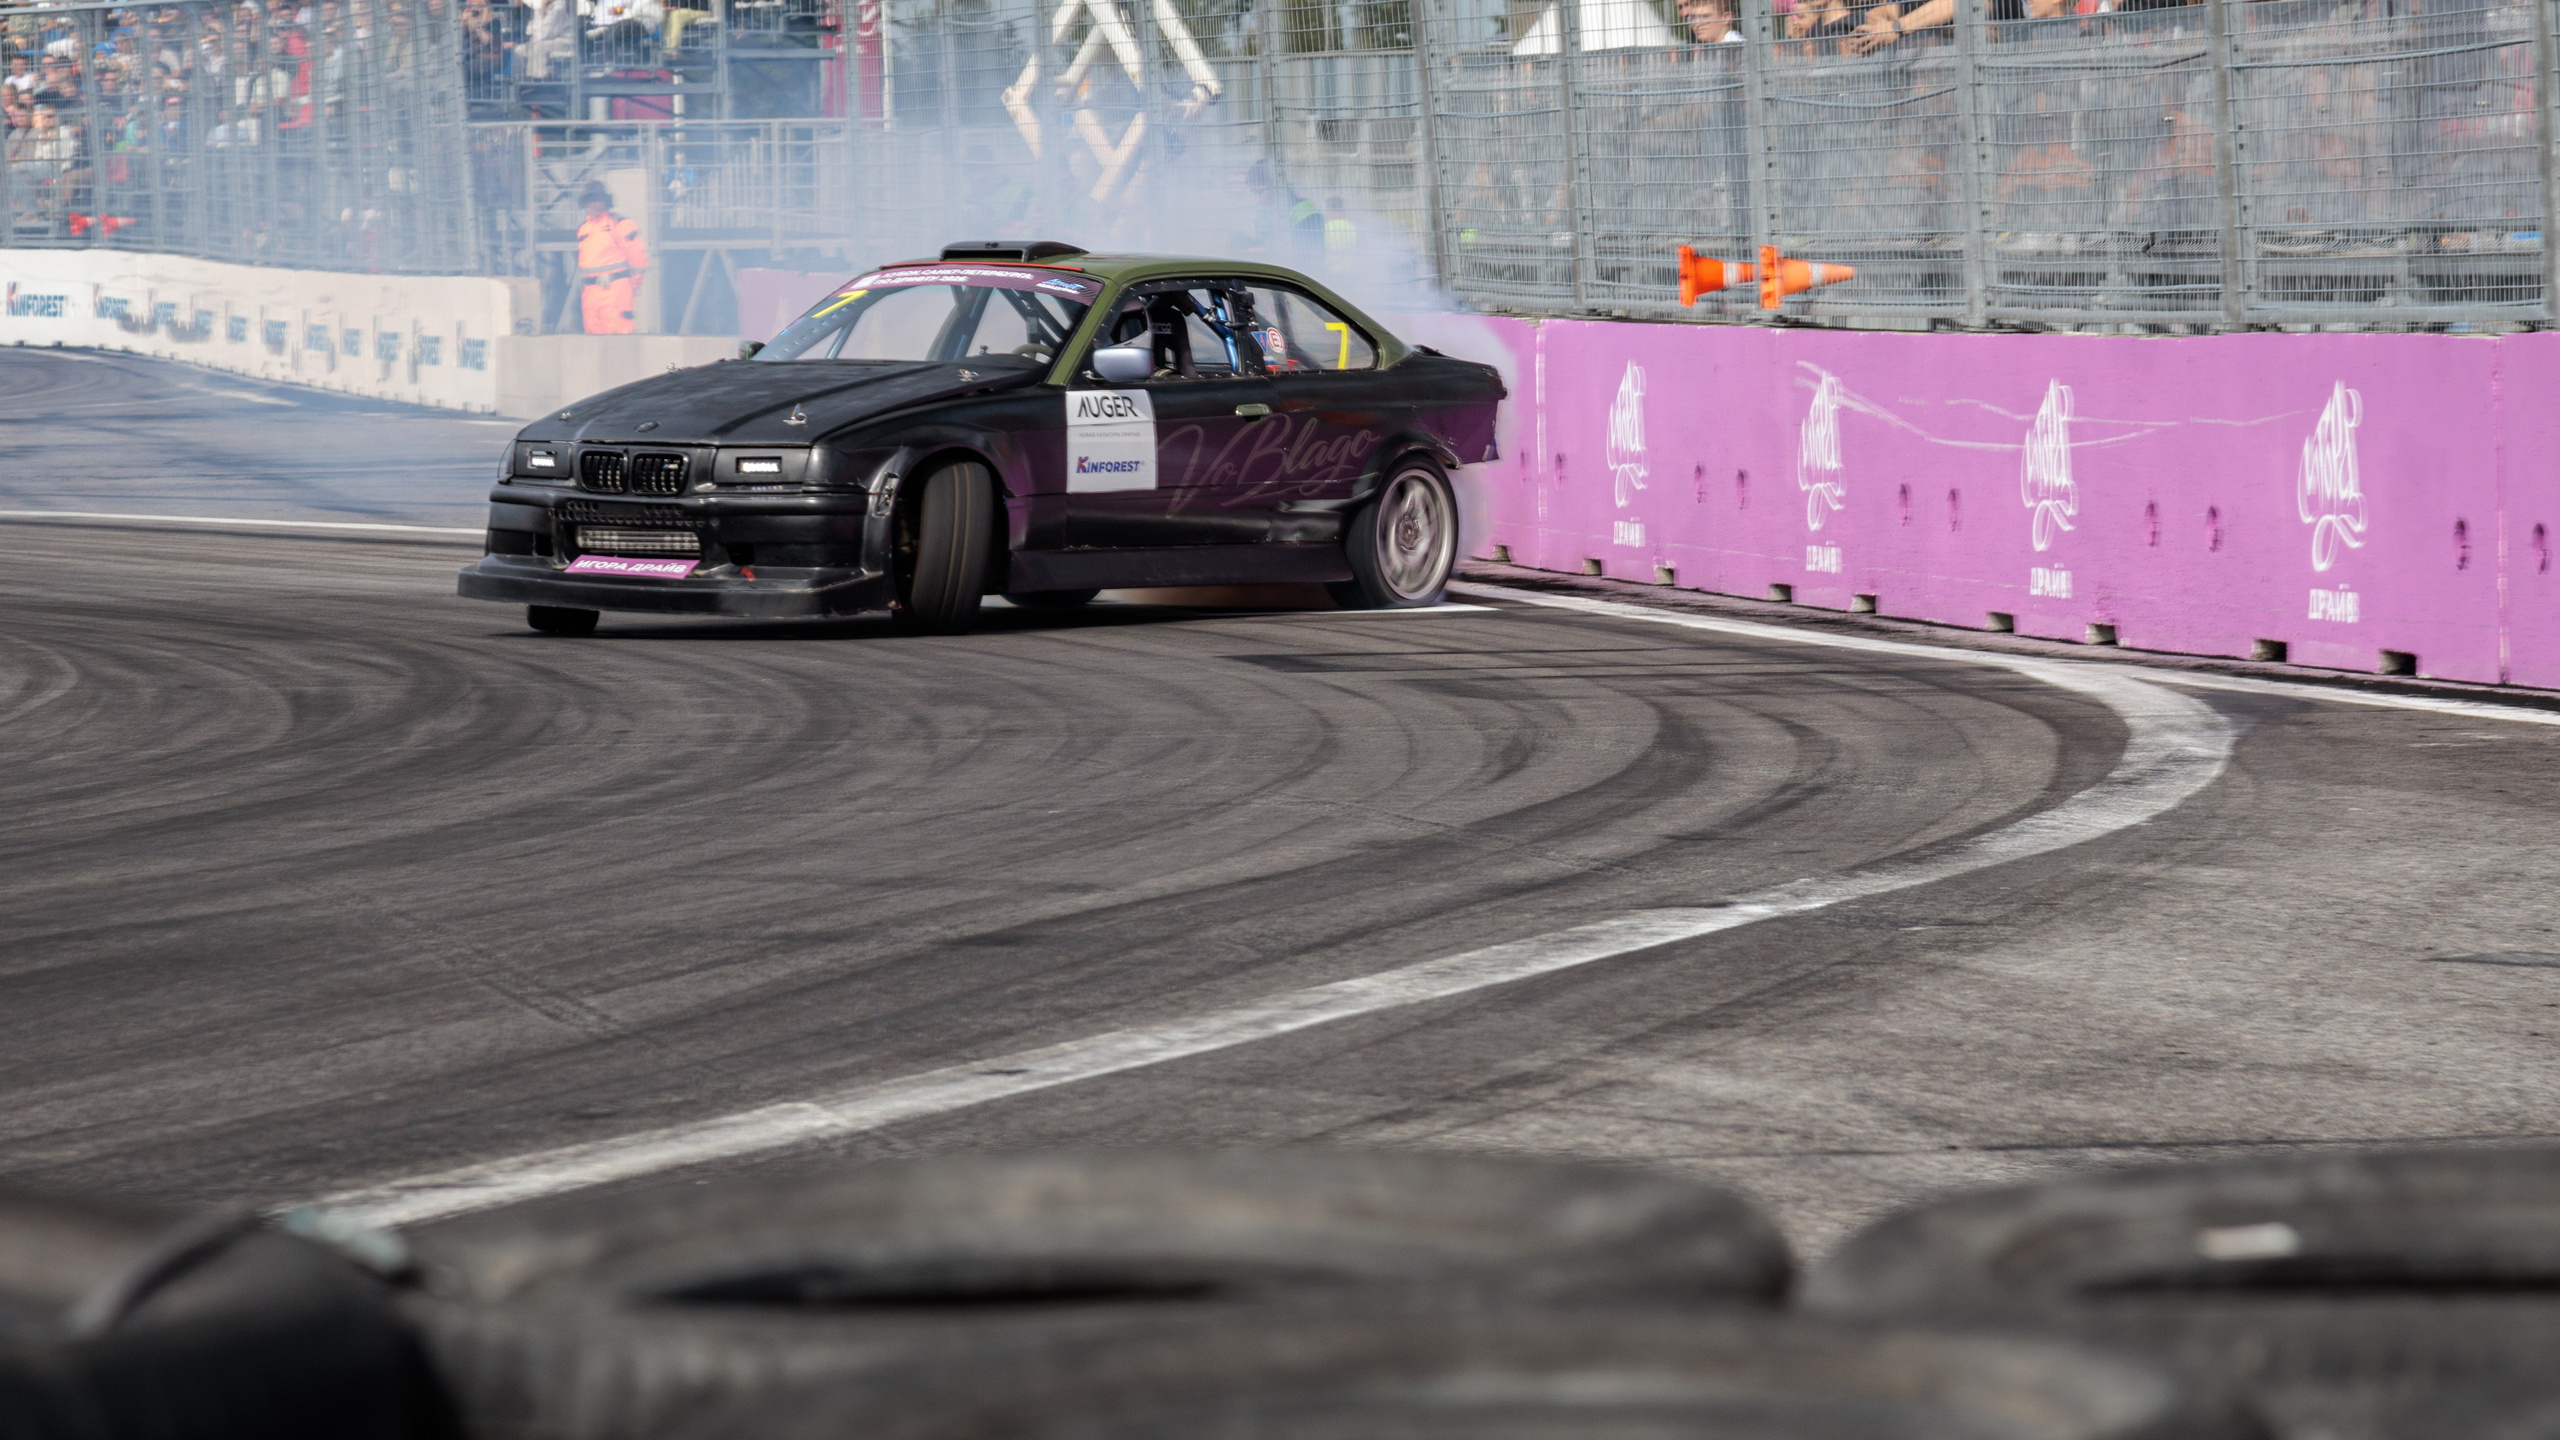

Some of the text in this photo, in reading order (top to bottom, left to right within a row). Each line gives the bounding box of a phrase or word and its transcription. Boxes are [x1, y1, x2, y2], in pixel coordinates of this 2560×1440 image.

[6, 281, 65, 318] KINFOREST
[1324, 322, 1351, 370] 7
[1077, 395, 1139, 418] AUGER
[1076, 456, 1140, 474] KINFOREST
[575, 559, 688, 574] ИГОРА ДРАЙВ
[2307, 584, 2361, 624] ДРАЙВ
